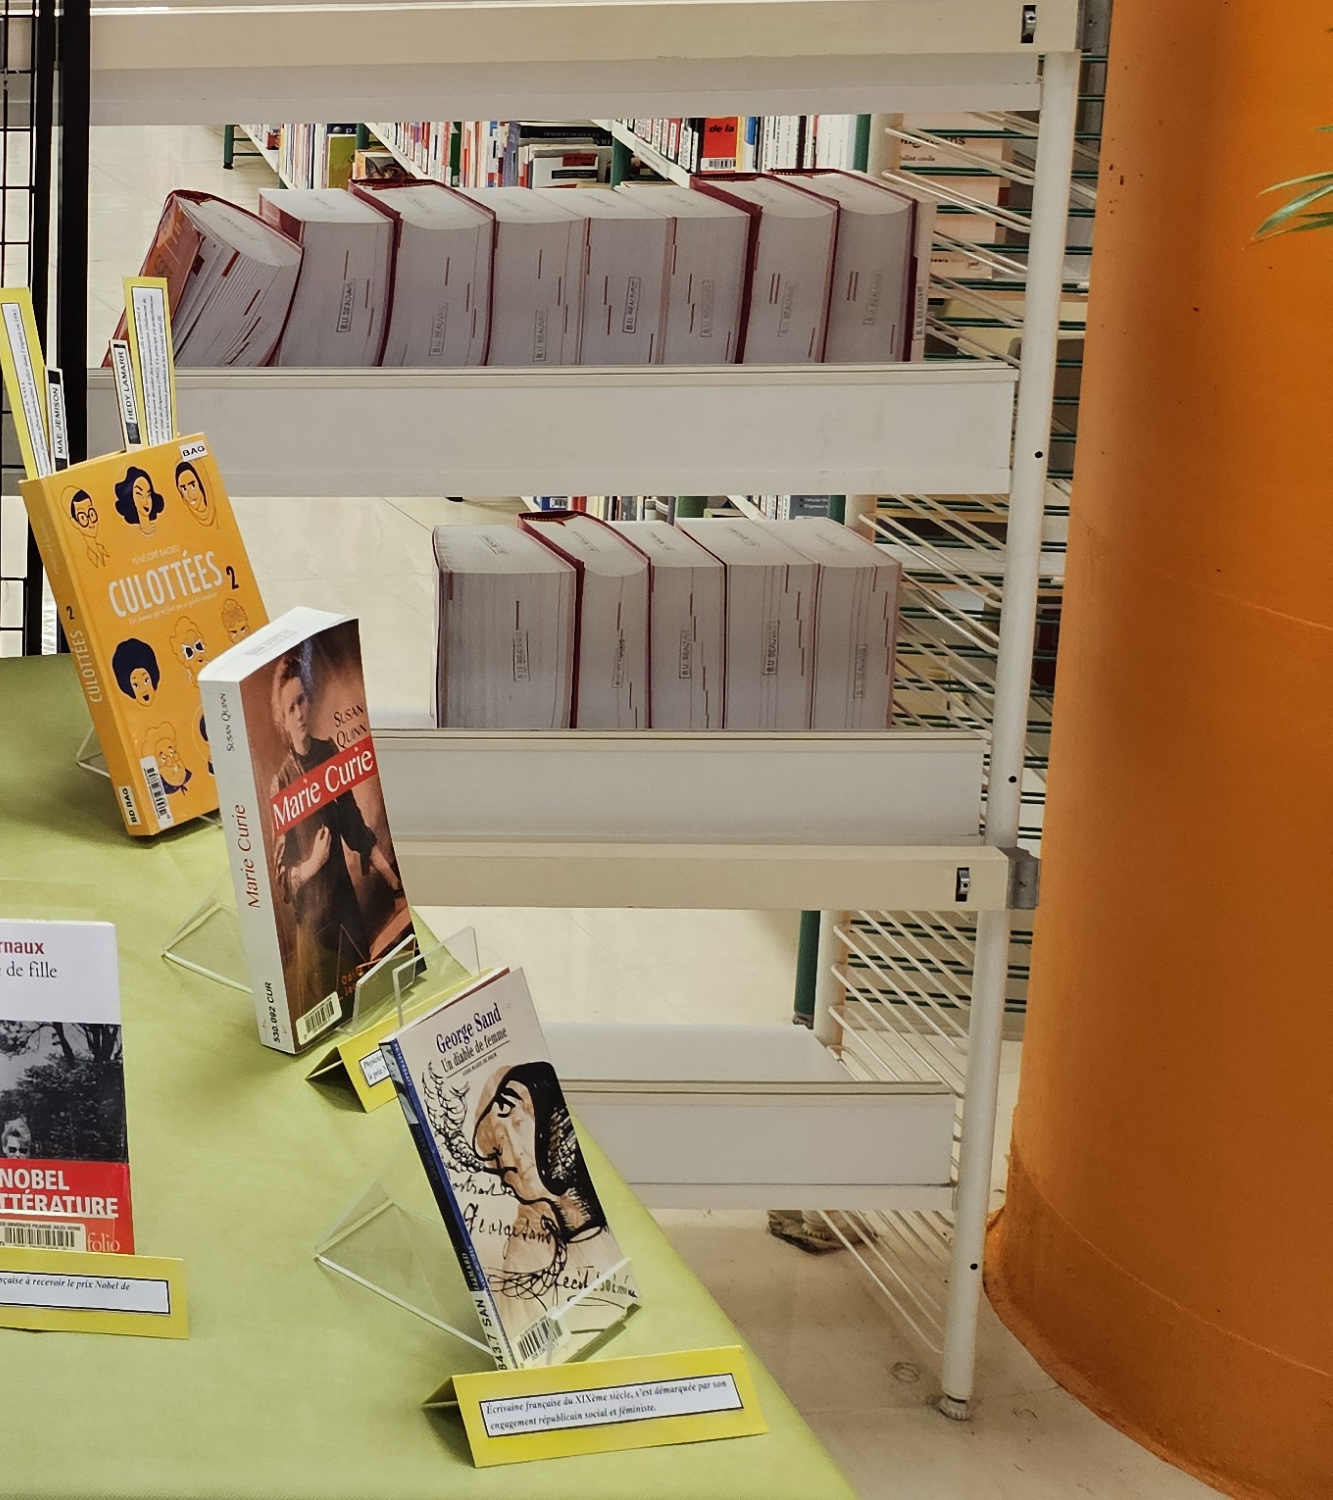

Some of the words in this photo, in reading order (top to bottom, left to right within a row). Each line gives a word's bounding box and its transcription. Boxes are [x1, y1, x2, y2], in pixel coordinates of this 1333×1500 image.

[118, 351, 130, 395] LAMARR
[51, 387, 62, 431] JEMISON
[125, 395, 134, 420] HEDY
[108, 551, 223, 618] CULOTTÉES
[226, 566, 239, 590] 2
[333, 704, 363, 727] SUSAN
[336, 723, 367, 749] QUINN
[272, 780, 321, 832] Marie
[324, 749, 374, 796] Curie
[235, 804, 251, 851] Curie
[246, 856, 260, 908] Marie
[6, 959, 24, 977] de
[28, 961, 57, 979] fille
[265, 982, 274, 1003] CUR
[269, 1006, 281, 1043] 530.092
[436, 1023, 474, 1054] George
[473, 1002, 502, 1032] Sand
[441, 1058, 454, 1073] Un
[453, 1046, 475, 1067] diable
[474, 1039, 485, 1054] de
[483, 1028, 508, 1049] femme
[87, 1232, 120, 1253] folio
[67, 1279, 74, 1288] le
[76, 1280, 93, 1289] prix
[95, 1280, 118, 1290] Nobel
[121, 1282, 130, 1291] de
[478, 1299, 492, 1327] SAN
